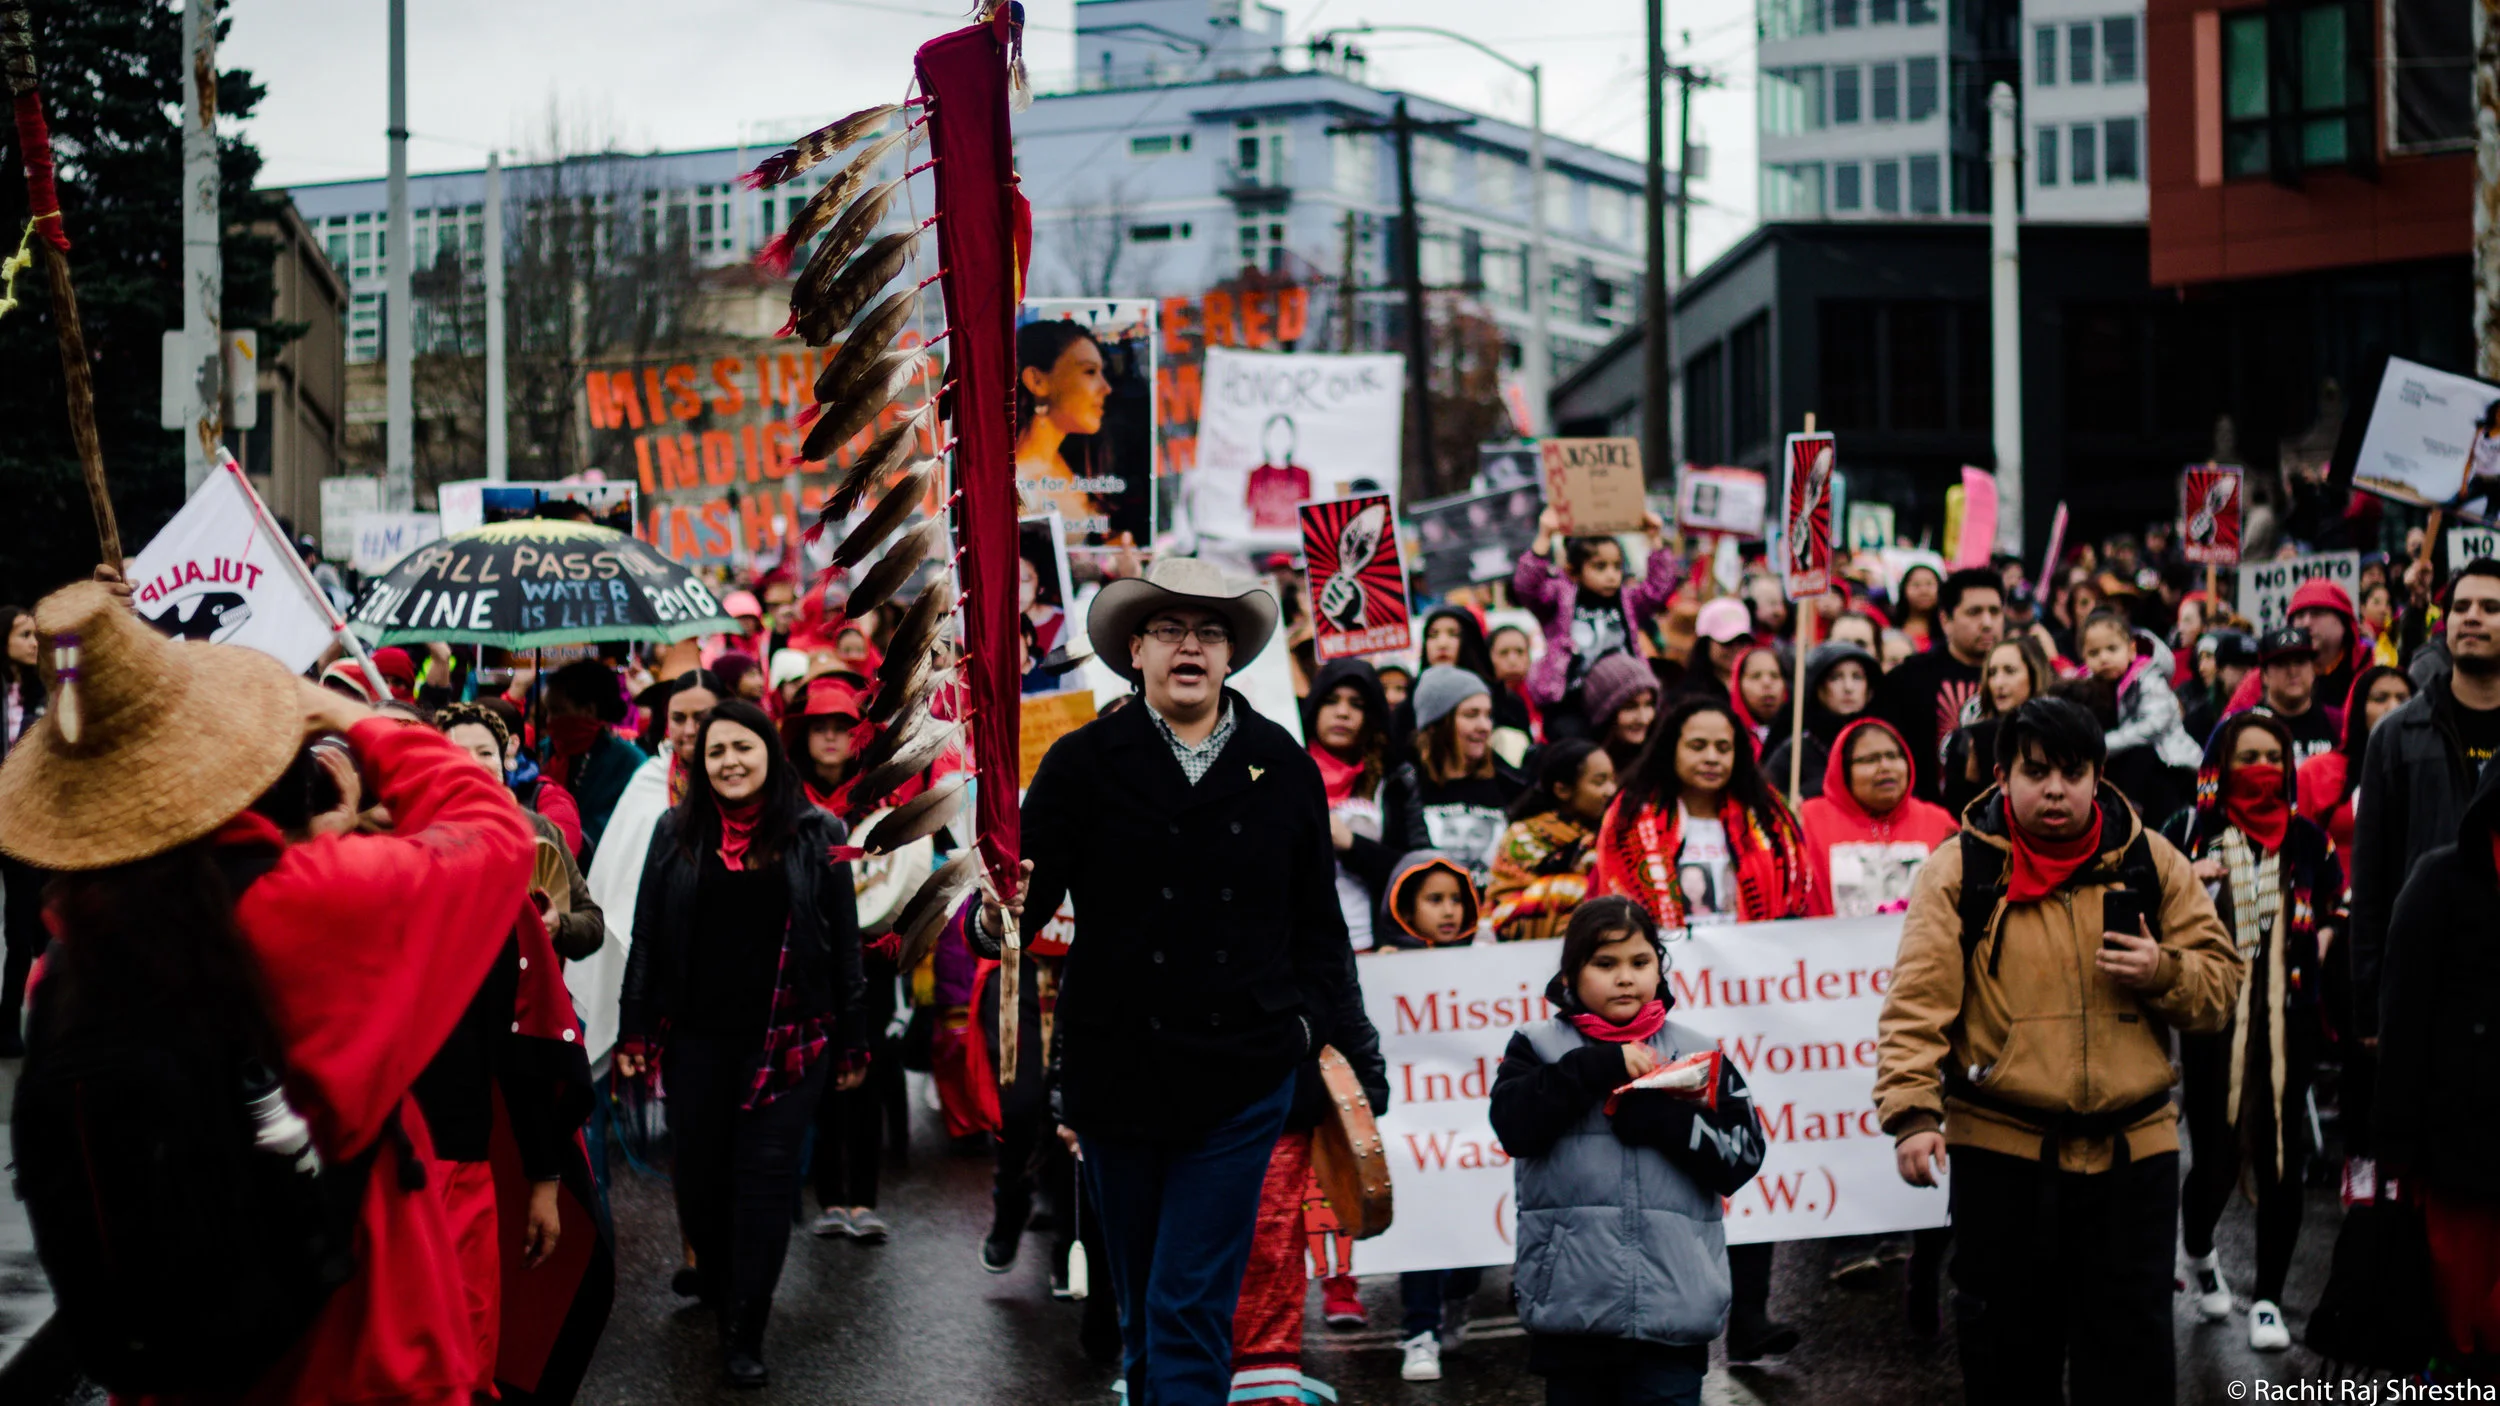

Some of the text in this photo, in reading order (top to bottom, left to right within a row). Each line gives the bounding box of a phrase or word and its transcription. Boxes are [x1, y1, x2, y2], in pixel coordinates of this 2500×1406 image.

[1564, 443, 1634, 469] JUSTICE
[1041, 477, 1066, 491] for
[1069, 474, 1127, 493] Jackie
[1063, 515, 1110, 532] or All
[2462, 535, 2494, 557] NO
[512, 545, 620, 580] PASS
[521, 578, 630, 602] WATER
[2255, 567, 2286, 590] NO
[642, 576, 718, 621] 2018
[521, 601, 631, 629] IS LIFE
[1671, 958, 1891, 1010] Murdere
[1716, 1033, 1877, 1075] Wome
[1404, 1130, 1511, 1173] Was
[1756, 1101, 1883, 1144] Marc
